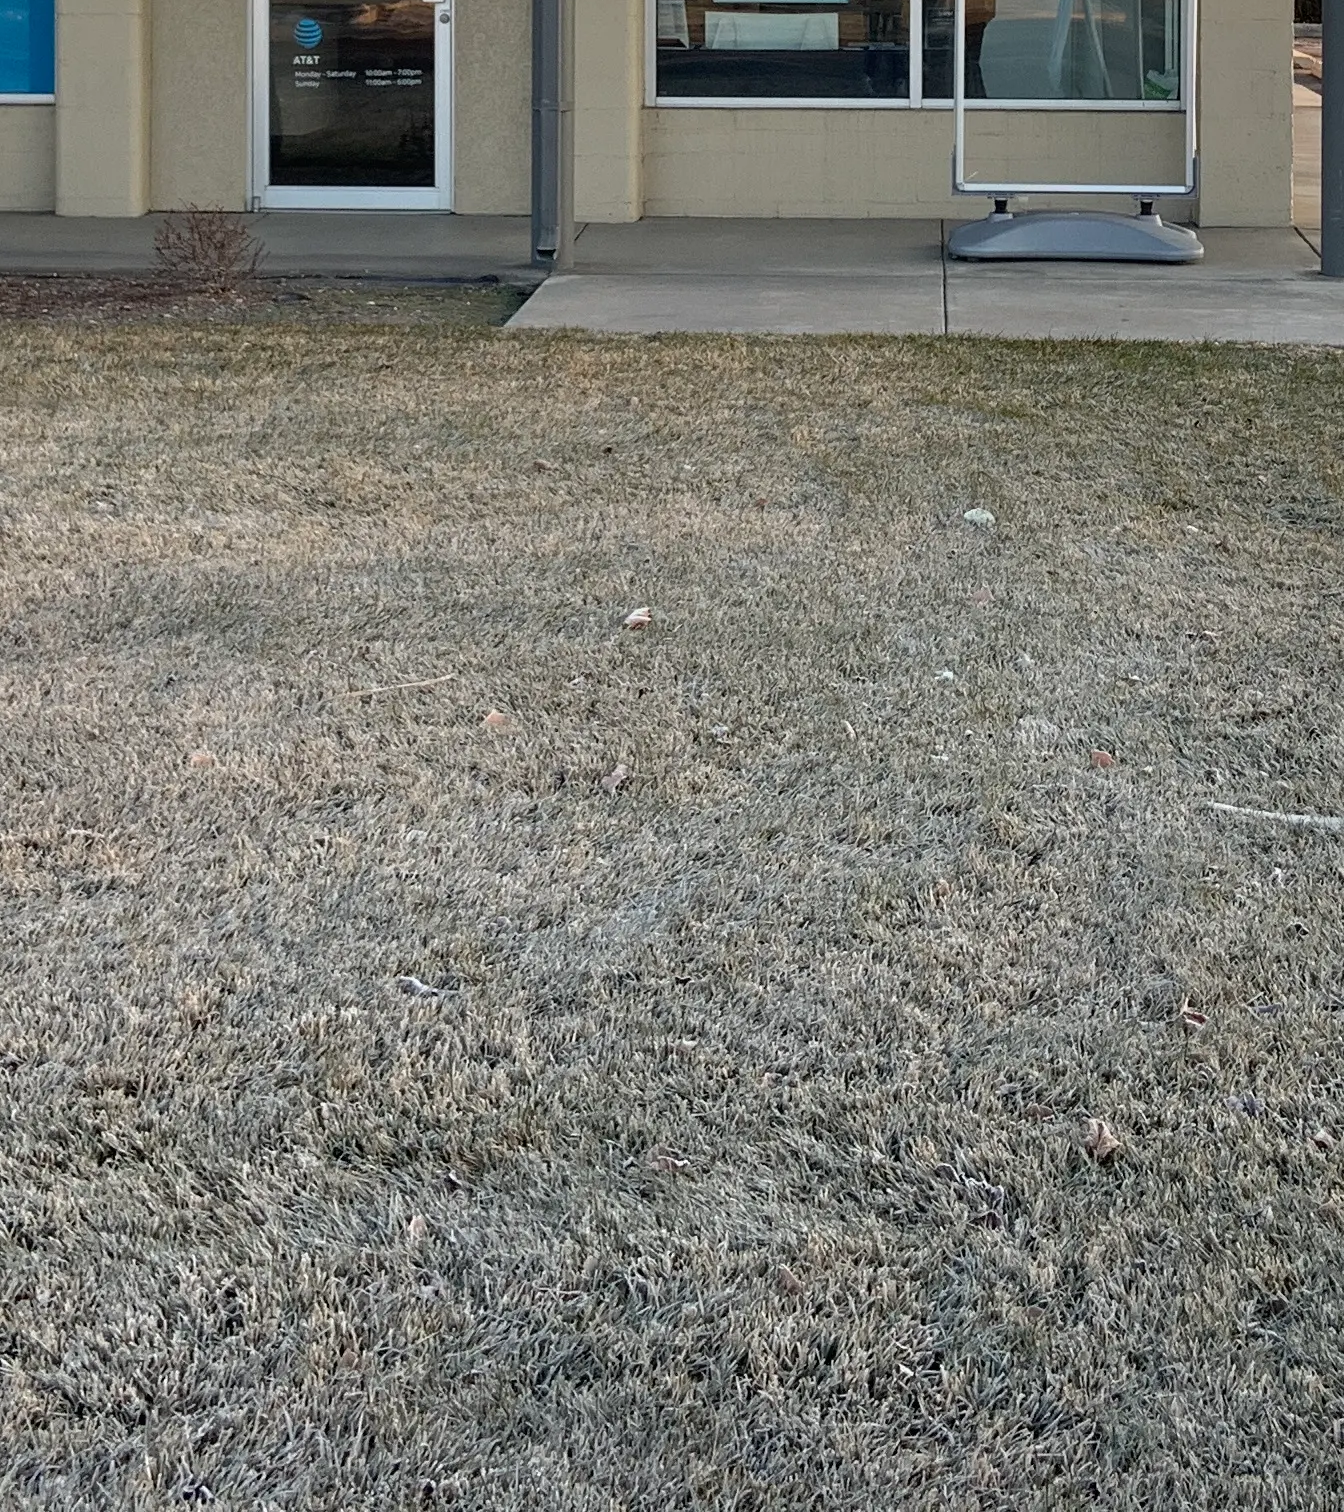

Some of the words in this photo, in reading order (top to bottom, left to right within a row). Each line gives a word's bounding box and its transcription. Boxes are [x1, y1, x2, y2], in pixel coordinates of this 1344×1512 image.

[293, 55, 321, 65] AT&T
[295, 71, 321, 79] Monday
[327, 70, 356, 79] Saturday
[295, 80, 320, 88] Sunday
